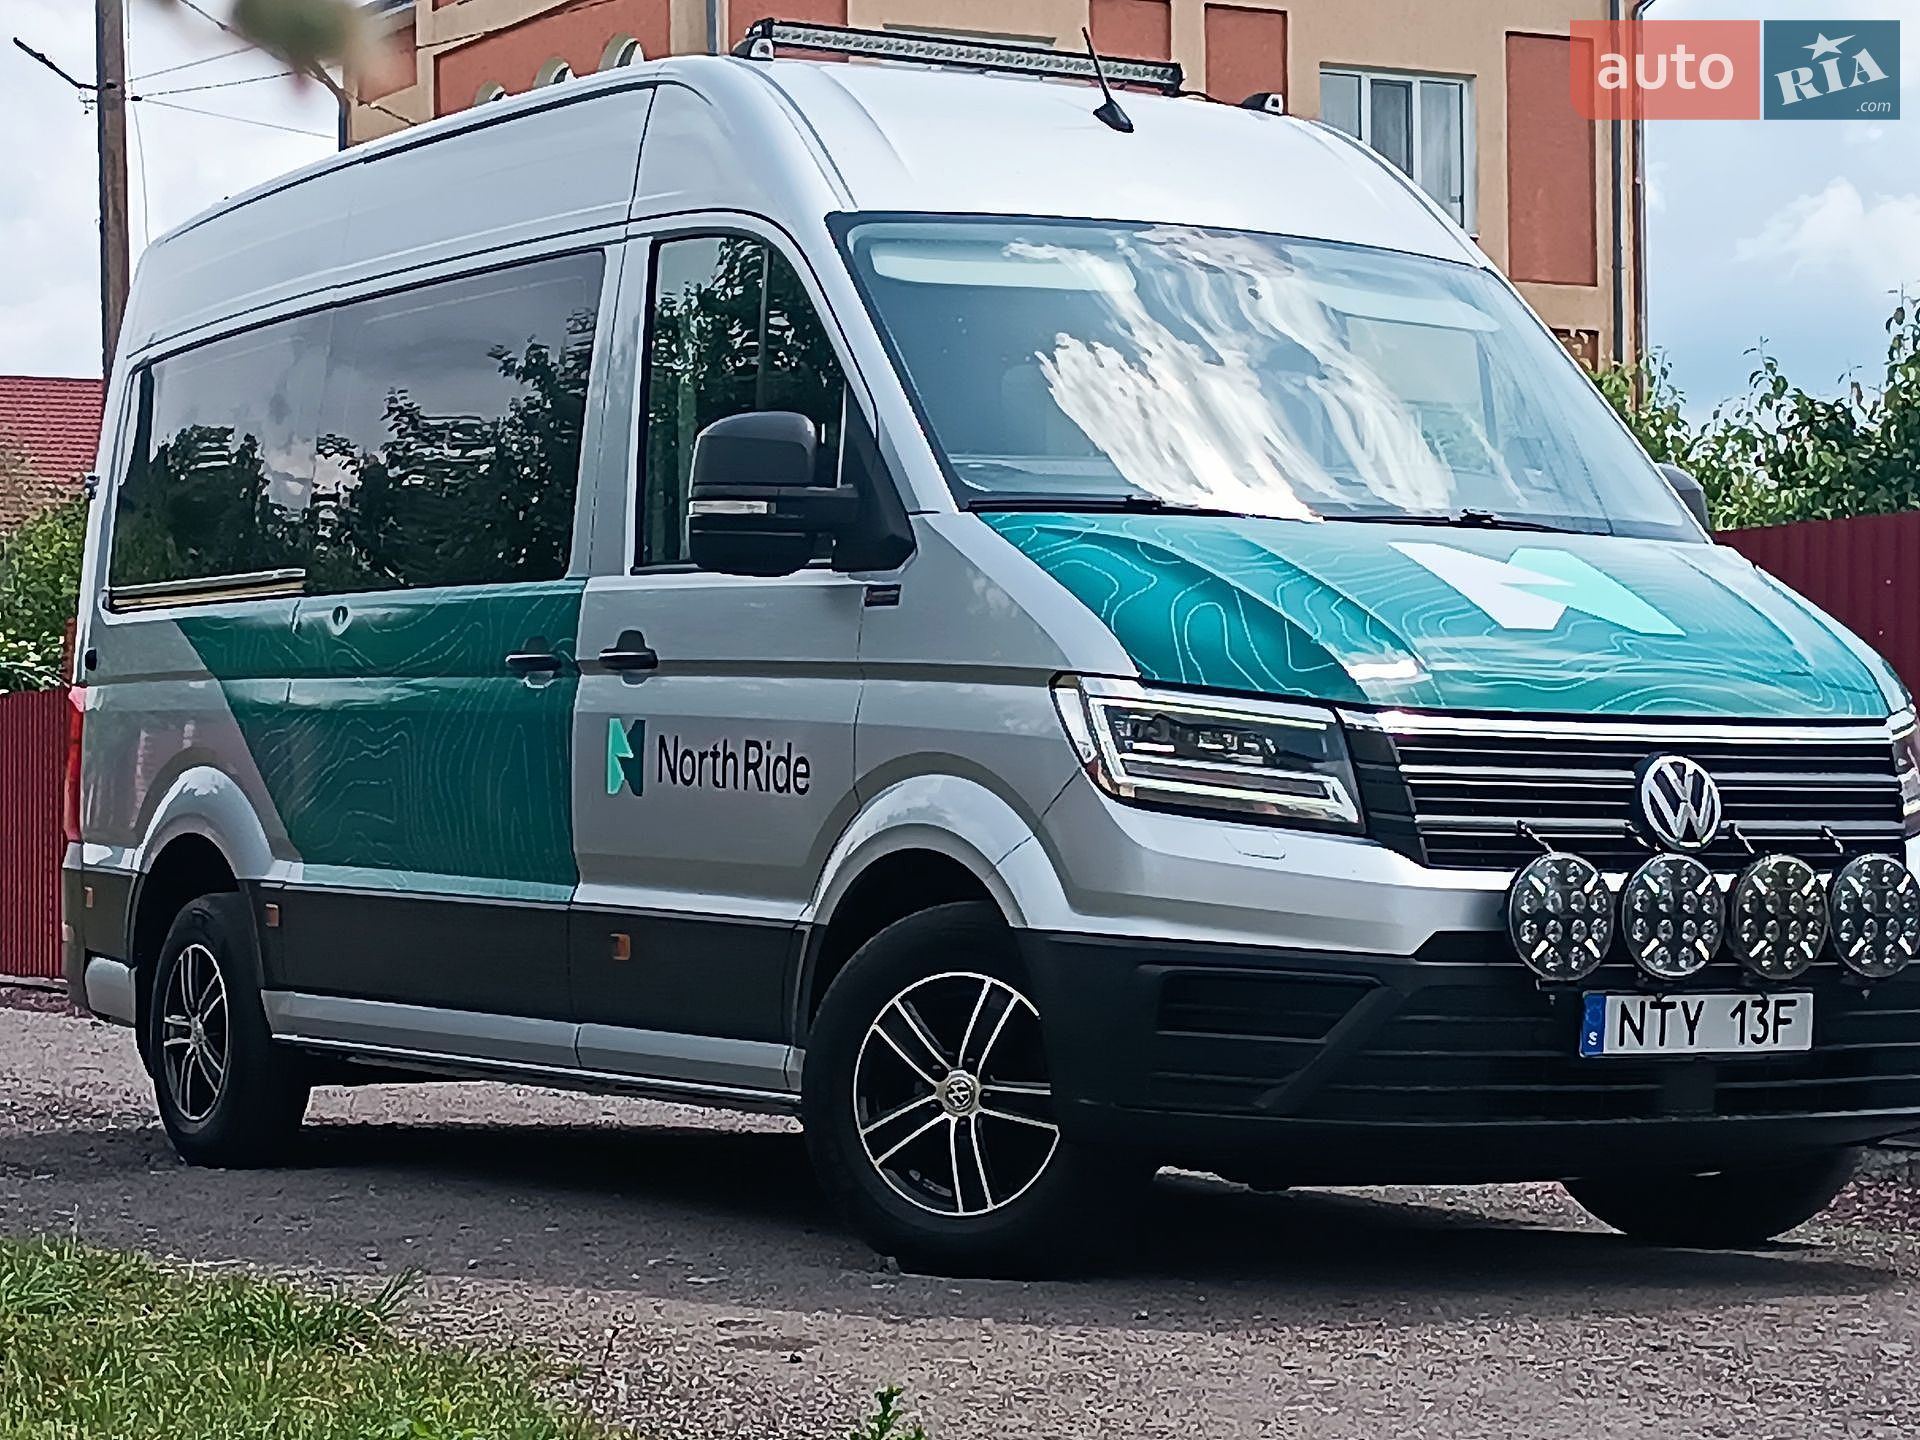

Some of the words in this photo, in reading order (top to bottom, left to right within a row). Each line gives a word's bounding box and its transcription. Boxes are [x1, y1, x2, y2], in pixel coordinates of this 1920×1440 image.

[1588, 1031, 1598, 1046] S
[1618, 1000, 1704, 1047] NTY
[1729, 999, 1798, 1045] 13F
